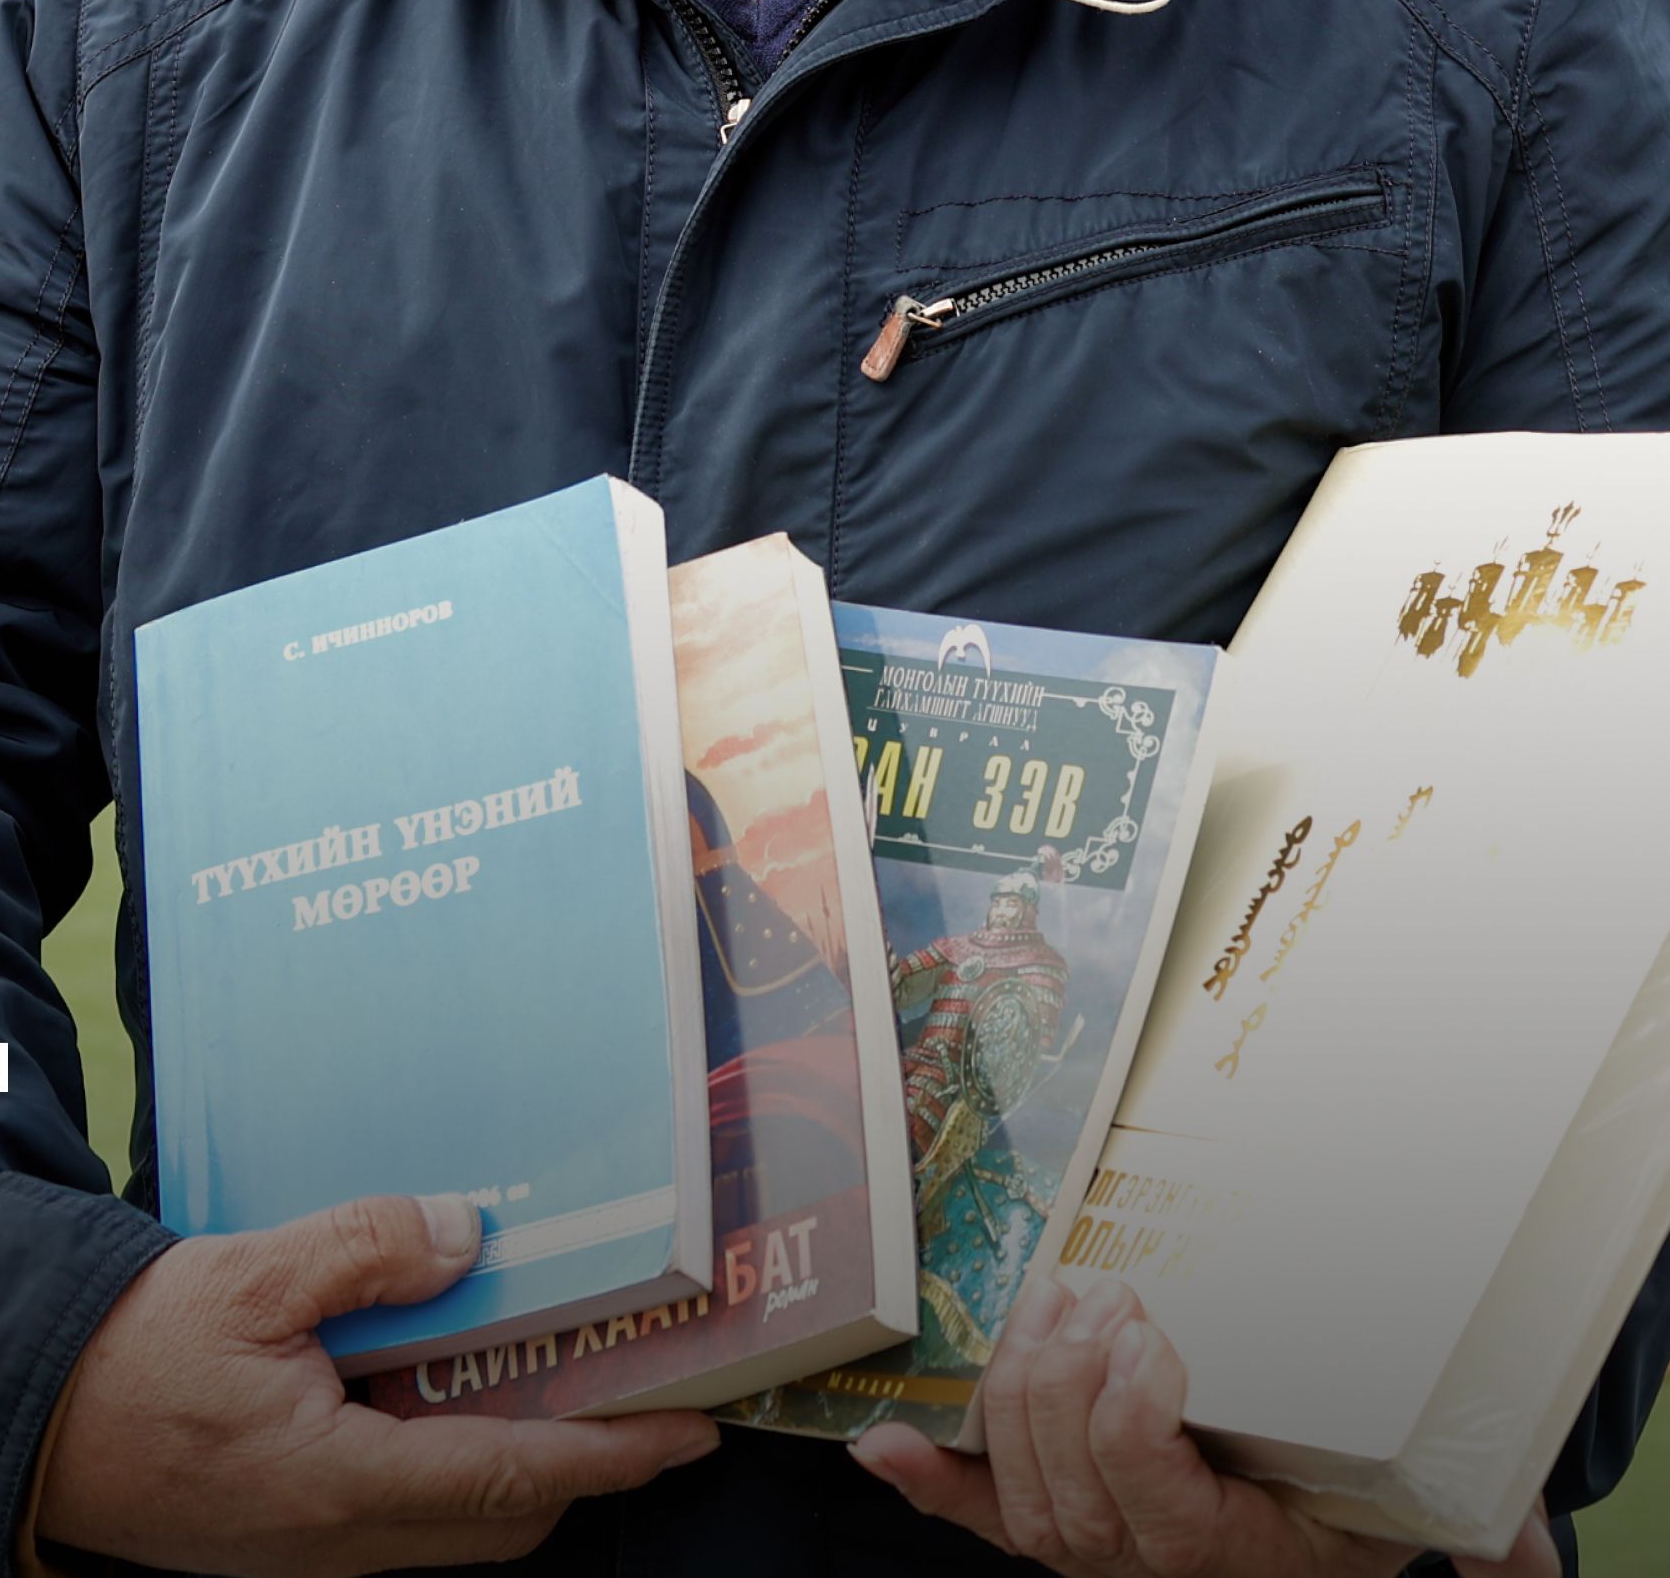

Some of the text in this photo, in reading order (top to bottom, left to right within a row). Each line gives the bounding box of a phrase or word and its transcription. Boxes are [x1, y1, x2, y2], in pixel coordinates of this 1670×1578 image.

[283, 641, 305, 662] С.
[879, 665, 1046, 708] МОНГОЛЫН ТҮҮХИЙН
[873, 688, 971, 720] ГАЙХАМШИГТ
[973, 754, 1085, 839] ЗЭВ
[191, 766, 583, 905] ТҮҮХИЙН ҮНЭНИЙ
[292, 856, 481, 932] МӨРӨӨР
[725, 1217, 818, 1307] БАТ
